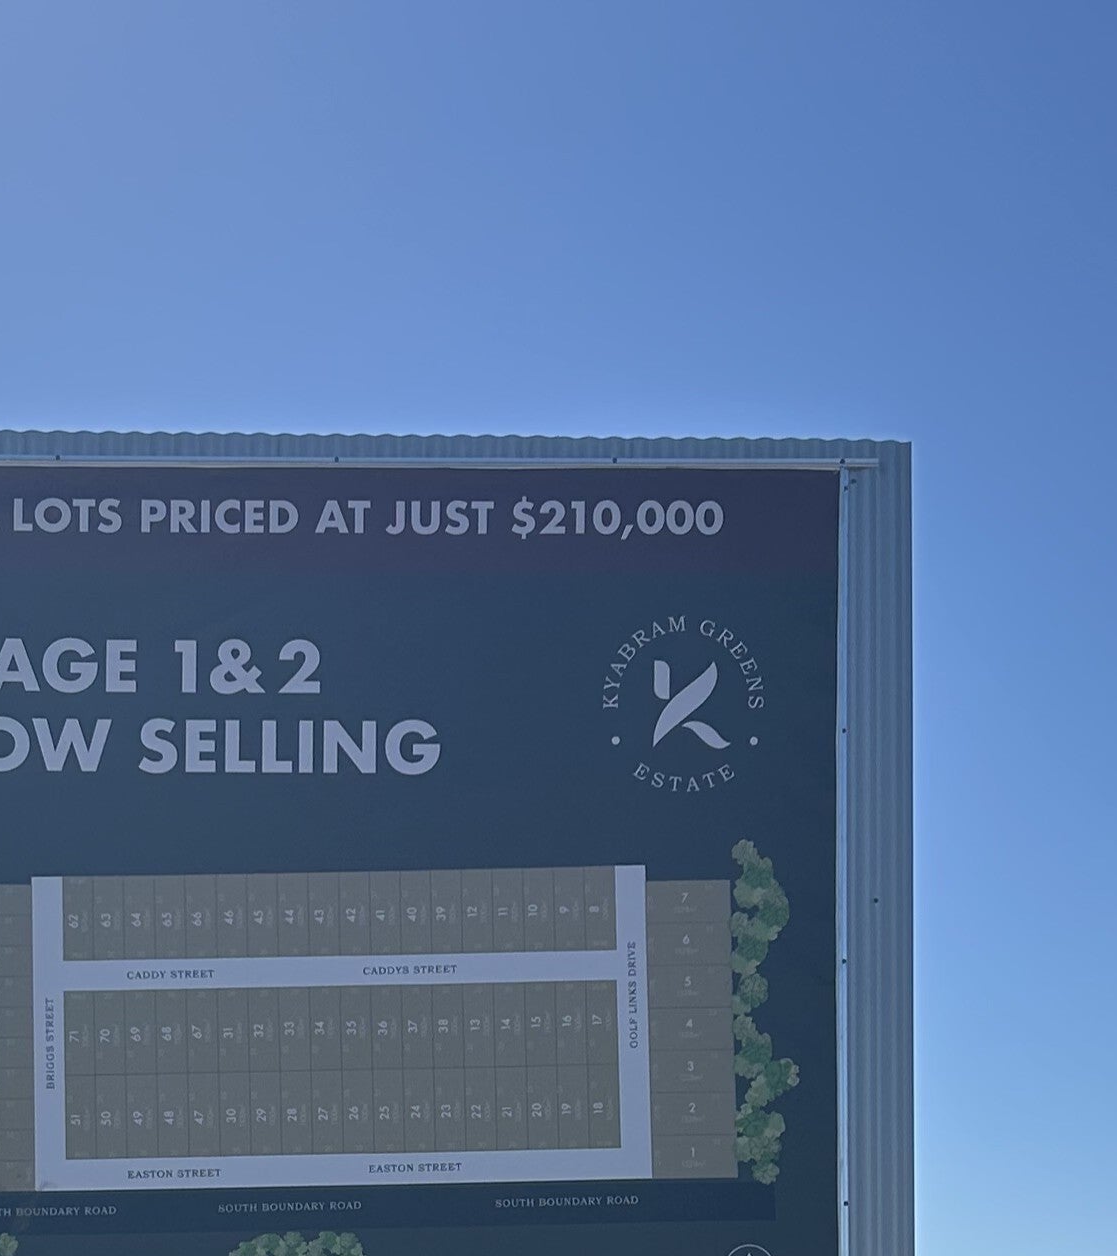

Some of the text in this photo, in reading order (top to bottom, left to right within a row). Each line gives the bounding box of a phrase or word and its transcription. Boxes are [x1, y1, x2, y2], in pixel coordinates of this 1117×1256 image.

[13, 497, 123, 534] LOTS
[140, 499, 299, 534] PRICED
[314, 499, 372, 534] AT
[385, 500, 495, 536] JUST
[511, 495, 724, 541] $210,000
[602, 615, 765, 710] KYABRAM GREENS
[138, 717, 441, 776] SELLING
[632, 762, 735, 793] ESTATE
[681, 892, 689, 904] 7
[223, 910, 234, 925] 46
[253, 910, 264, 925] 45
[284, 909, 294, 925] 44
[313, 909, 325, 925] 43
[345, 908, 356, 923] 42
[375, 909, 385, 922] 41
[406, 906, 418, 922] 40
[435, 906, 447, 921] 39
[466, 905, 478, 918] 12
[497, 906, 509, 917] 11
[527, 903, 538, 917] 10
[68, 914, 79, 929] 62
[100, 913, 112, 928] 63
[131, 912, 142, 928] 64
[161, 912, 172, 928] 65
[191, 911, 202, 927] 66
[126, 969, 215, 980] CADDY STREET
[362, 964, 458, 976] CADDYS STREET
[684, 975, 692, 987] 5
[626, 941, 639, 1049] GOLF LINKS DRIVE
[407, 1019, 418, 1034] 37
[437, 1018, 449, 1034] 38
[469, 1018, 481, 1031] 13
[500, 1018, 511, 1030] 14
[530, 1016, 541, 1028] 15
[561, 1015, 572, 1027] 16
[591, 1014, 602, 1025] 17
[685, 1018, 693, 1028] 4
[99, 1028, 111, 1043] 70
[130, 1026, 142, 1042] 69
[161, 1026, 172, 1042] 68
[191, 1024, 203, 1040] 67
[222, 1027, 234, 1039] 31
[253, 1023, 264, 1038] 32
[283, 1021, 295, 1036] 33
[314, 1021, 325, 1035] 34
[345, 1020, 357, 1036] 35
[377, 1020, 388, 1036] 36
[44, 997, 56, 1090] BRIGGS STREET
[68, 1030, 80, 1043] 71
[687, 1060, 695, 1072] 3
[256, 1107, 267, 1122] 29
[286, 1107, 298, 1122] 28
[317, 1106, 329, 1121] 27
[348, 1105, 359, 1121] 26
[379, 1105, 390, 1121] 25
[410, 1105, 421, 1119] 24
[440, 1104, 452, 1119] 23
[470, 1104, 482, 1119] 22
[501, 1106, 513, 1118] 21
[531, 1102, 542, 1118] 20
[561, 1102, 572, 1115] 19
[592, 1101, 604, 1114] 18
[688, 1102, 696, 1113] 2
[70, 1114, 81, 1126] 51
[100, 1110, 112, 1127] 50
[132, 1110, 143, 1126] 49
[163, 1110, 174, 1125] 48
[193, 1110, 204, 1126] 47
[225, 1108, 237, 1124] 30
[127, 1168, 222, 1180] EASTON STREET
[368, 1162, 463, 1174] EASTON STREET
[218, 1200, 362, 1213] SOUTH BOUNDARY ROAD
[495, 1195, 639, 1208] SOUTH BOUNDARY ROAD
[15, 1206, 81, 1217] BOUNDARY
[84, 1205, 117, 1216] ROAD
